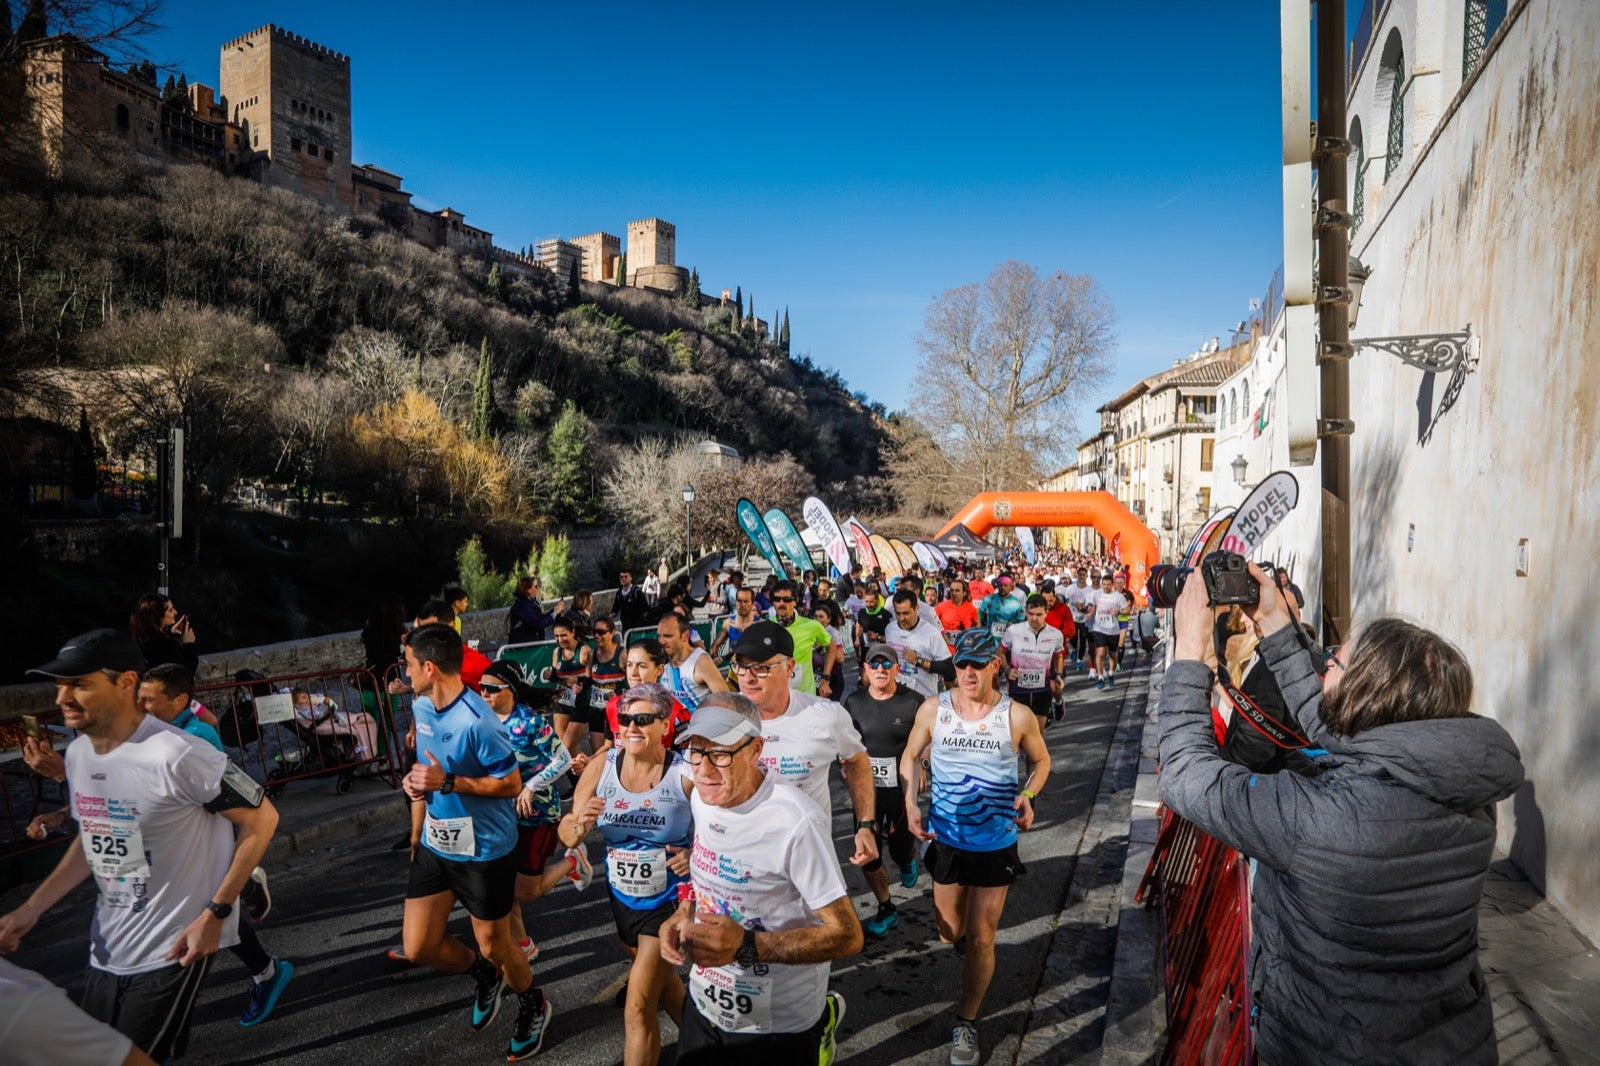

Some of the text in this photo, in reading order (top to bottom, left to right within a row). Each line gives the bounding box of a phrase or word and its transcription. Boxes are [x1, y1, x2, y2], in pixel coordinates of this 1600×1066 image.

[1237, 487, 1286, 534] MODEL
[1245, 494, 1291, 546] PLAST
[1228, 688, 1252, 711] EOS
[1250, 710, 1264, 722] 5D
[942, 737, 1001, 750] MARACENA
[604, 812, 667, 826] MARACENA
[430, 826, 461, 841] 337
[92, 835, 128, 857] 525
[719, 854, 732, 864] Ave
[617, 861, 652, 878] 578
[718, 870, 749, 884] Granada
[704, 984, 753, 1014] 459
